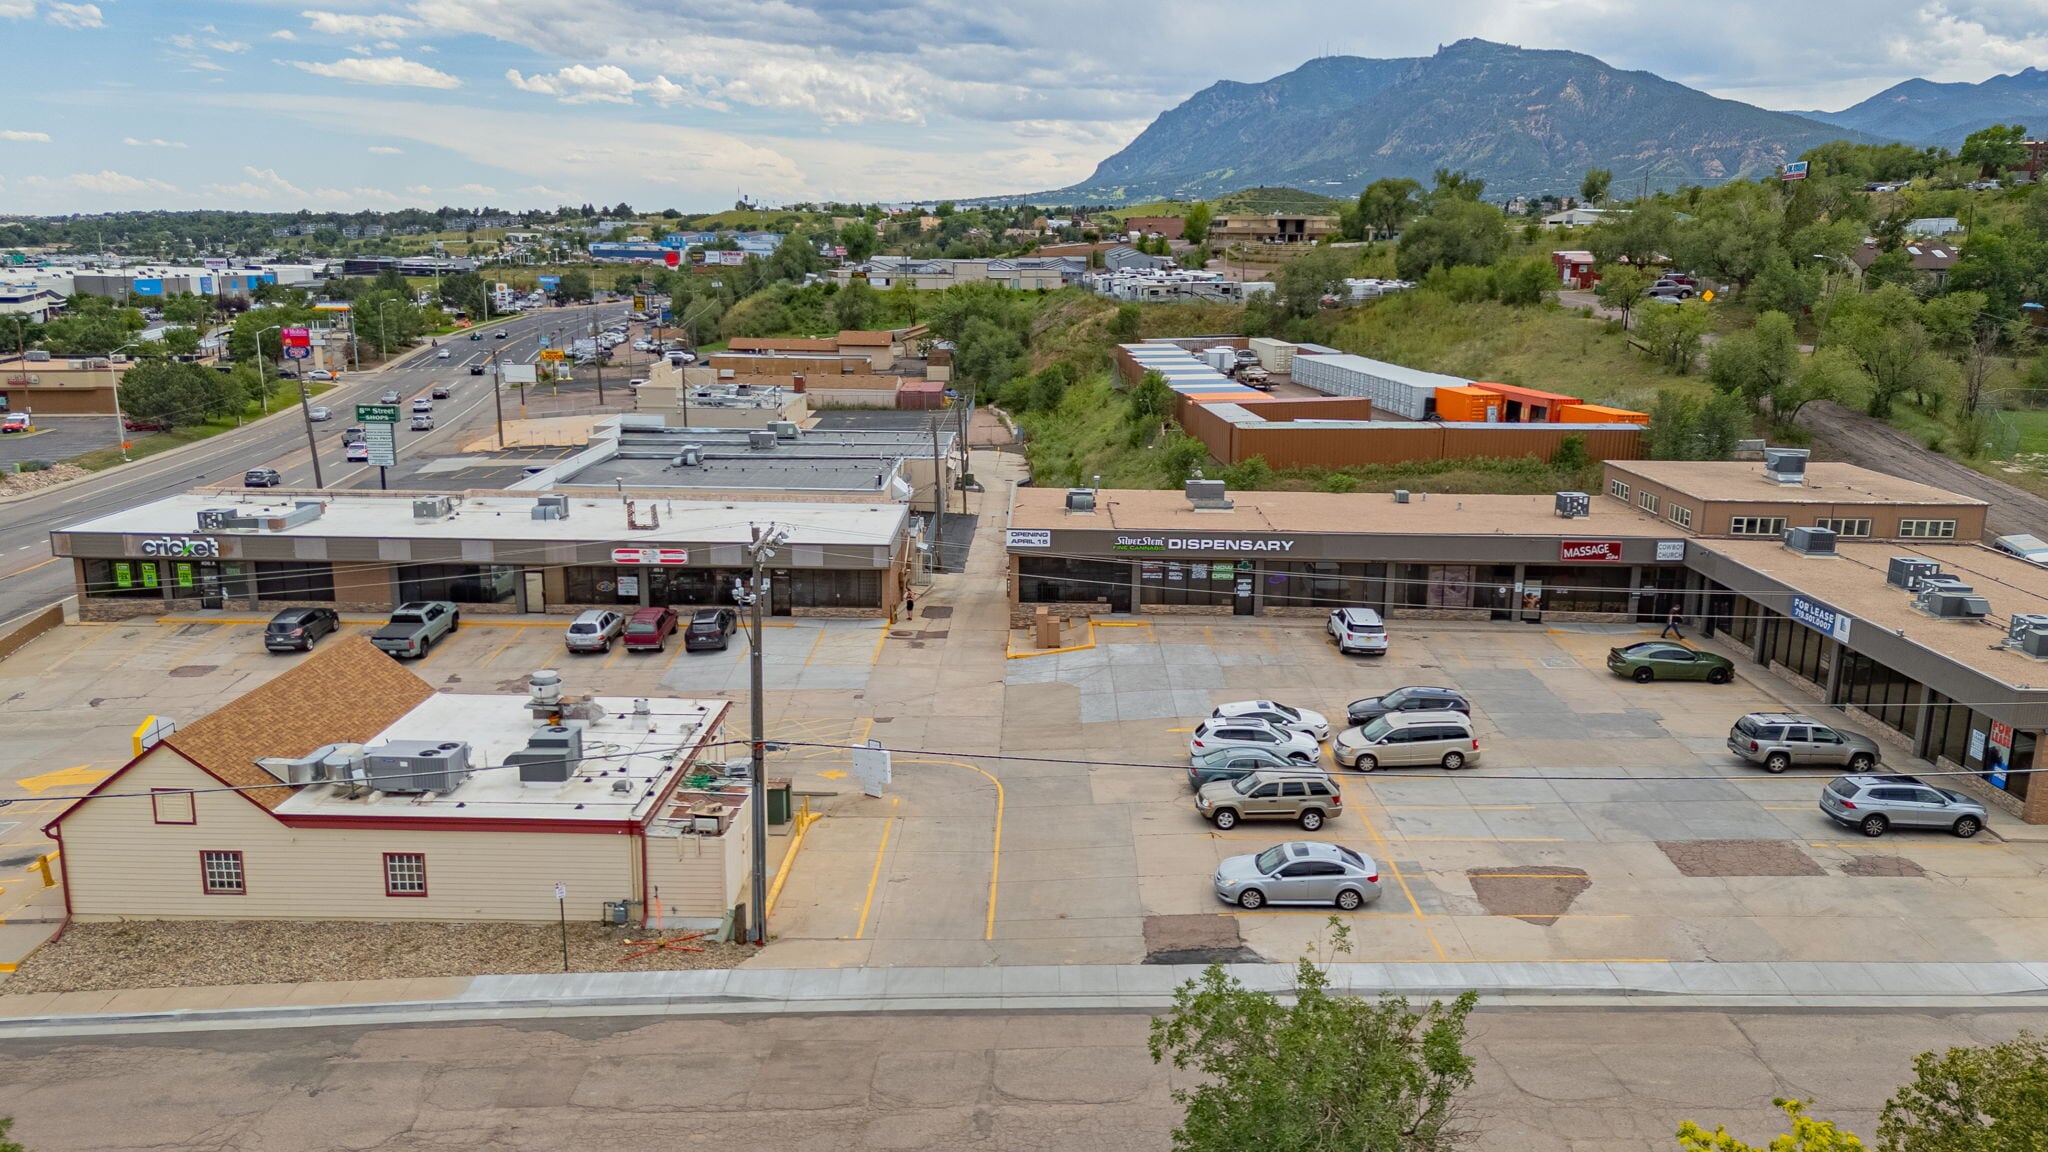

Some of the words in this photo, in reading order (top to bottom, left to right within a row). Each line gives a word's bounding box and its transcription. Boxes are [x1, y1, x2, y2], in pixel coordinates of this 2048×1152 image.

[142, 537, 219, 558] cricket
[1167, 538, 1295, 551] DISPENSARY
[1563, 543, 1610, 558] MASSAGE
[1658, 542, 1684, 551] COWBOY
[1605, 552, 1619, 560] Spa
[1657, 551, 1683, 559] CHURCH
[1212, 572, 1234, 580] OPEN
[1794, 598, 1810, 612] FOR
[1810, 606, 1835, 623] LEASE
[1795, 608, 1832, 630] 719.501.0007
[1992, 719, 2013, 737] FOR
